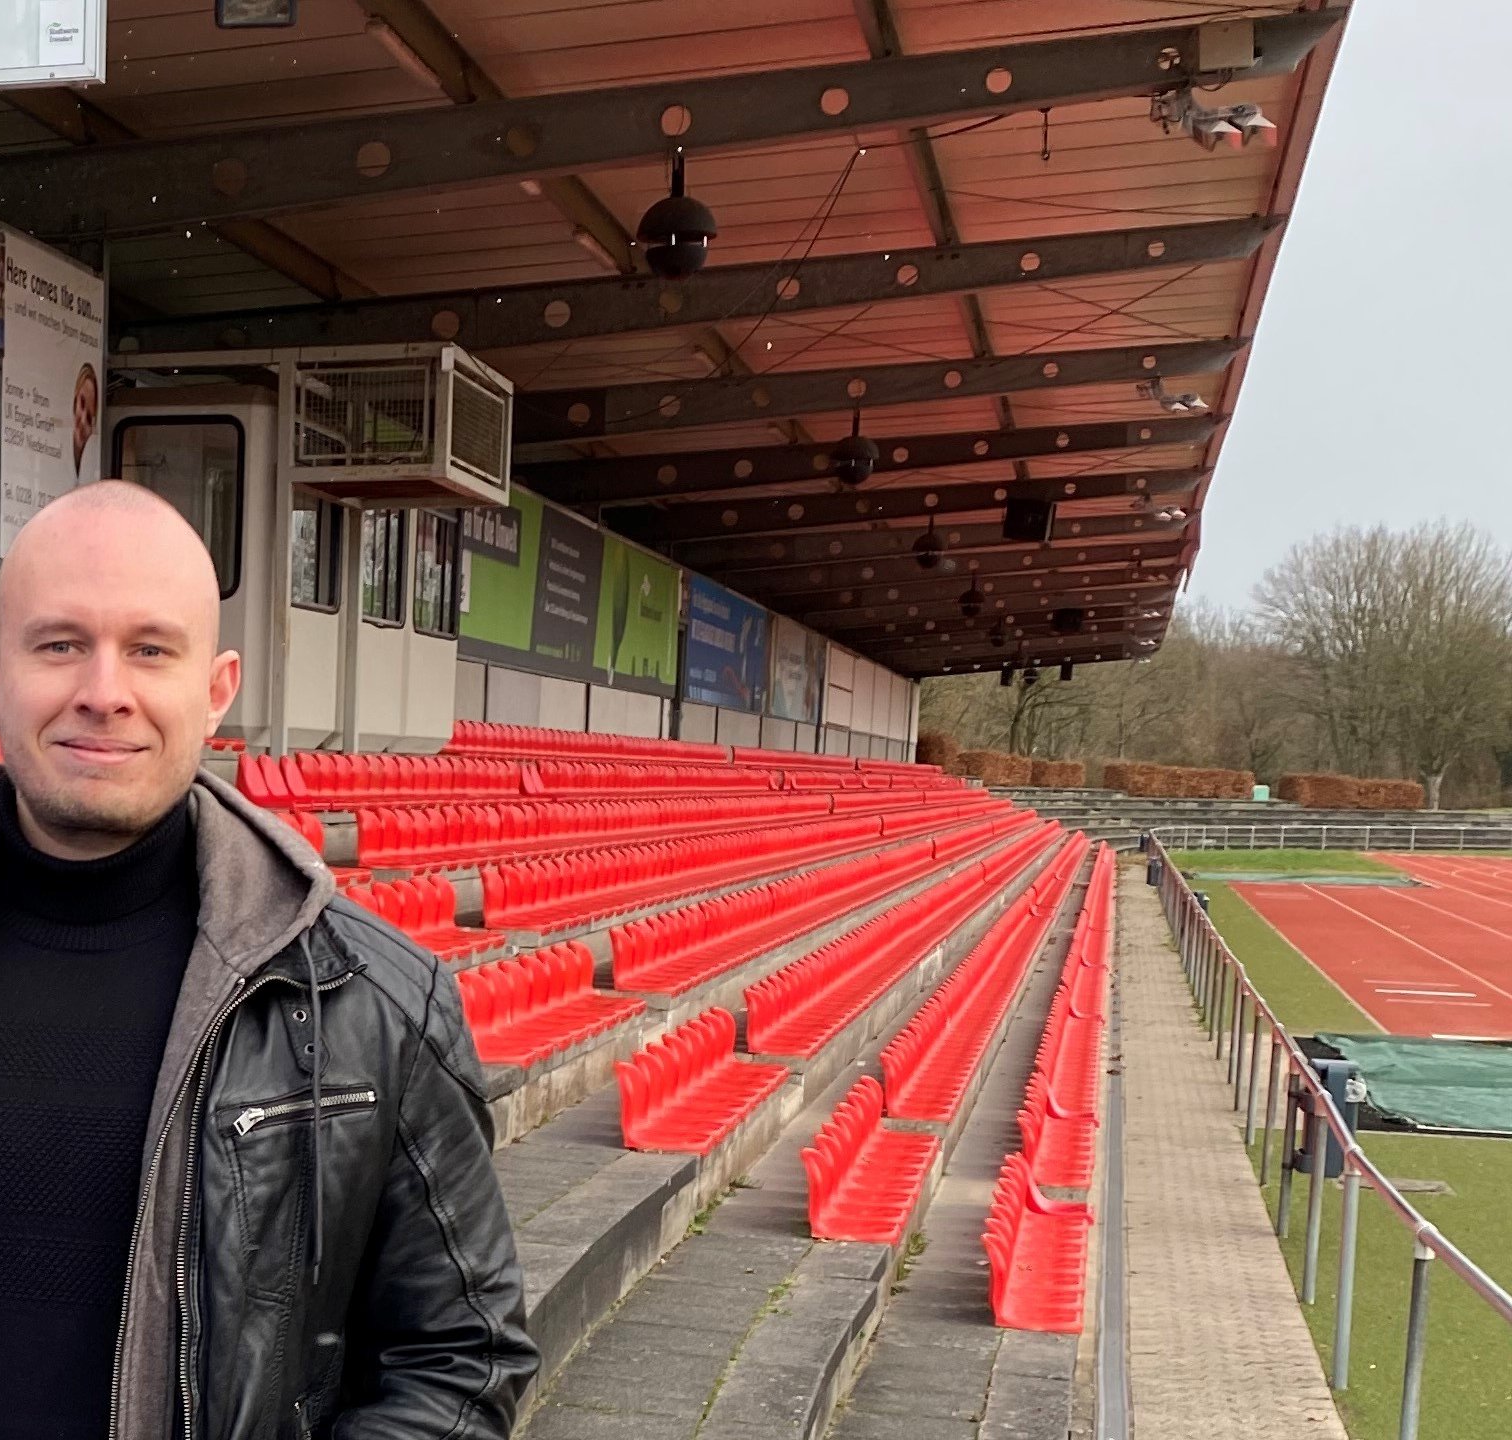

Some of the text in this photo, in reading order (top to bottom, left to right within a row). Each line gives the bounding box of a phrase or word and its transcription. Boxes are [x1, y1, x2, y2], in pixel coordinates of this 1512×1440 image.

[7, 256, 27, 289] Here
[30, 274, 57, 304] comes
[61, 284, 74, 311] the
